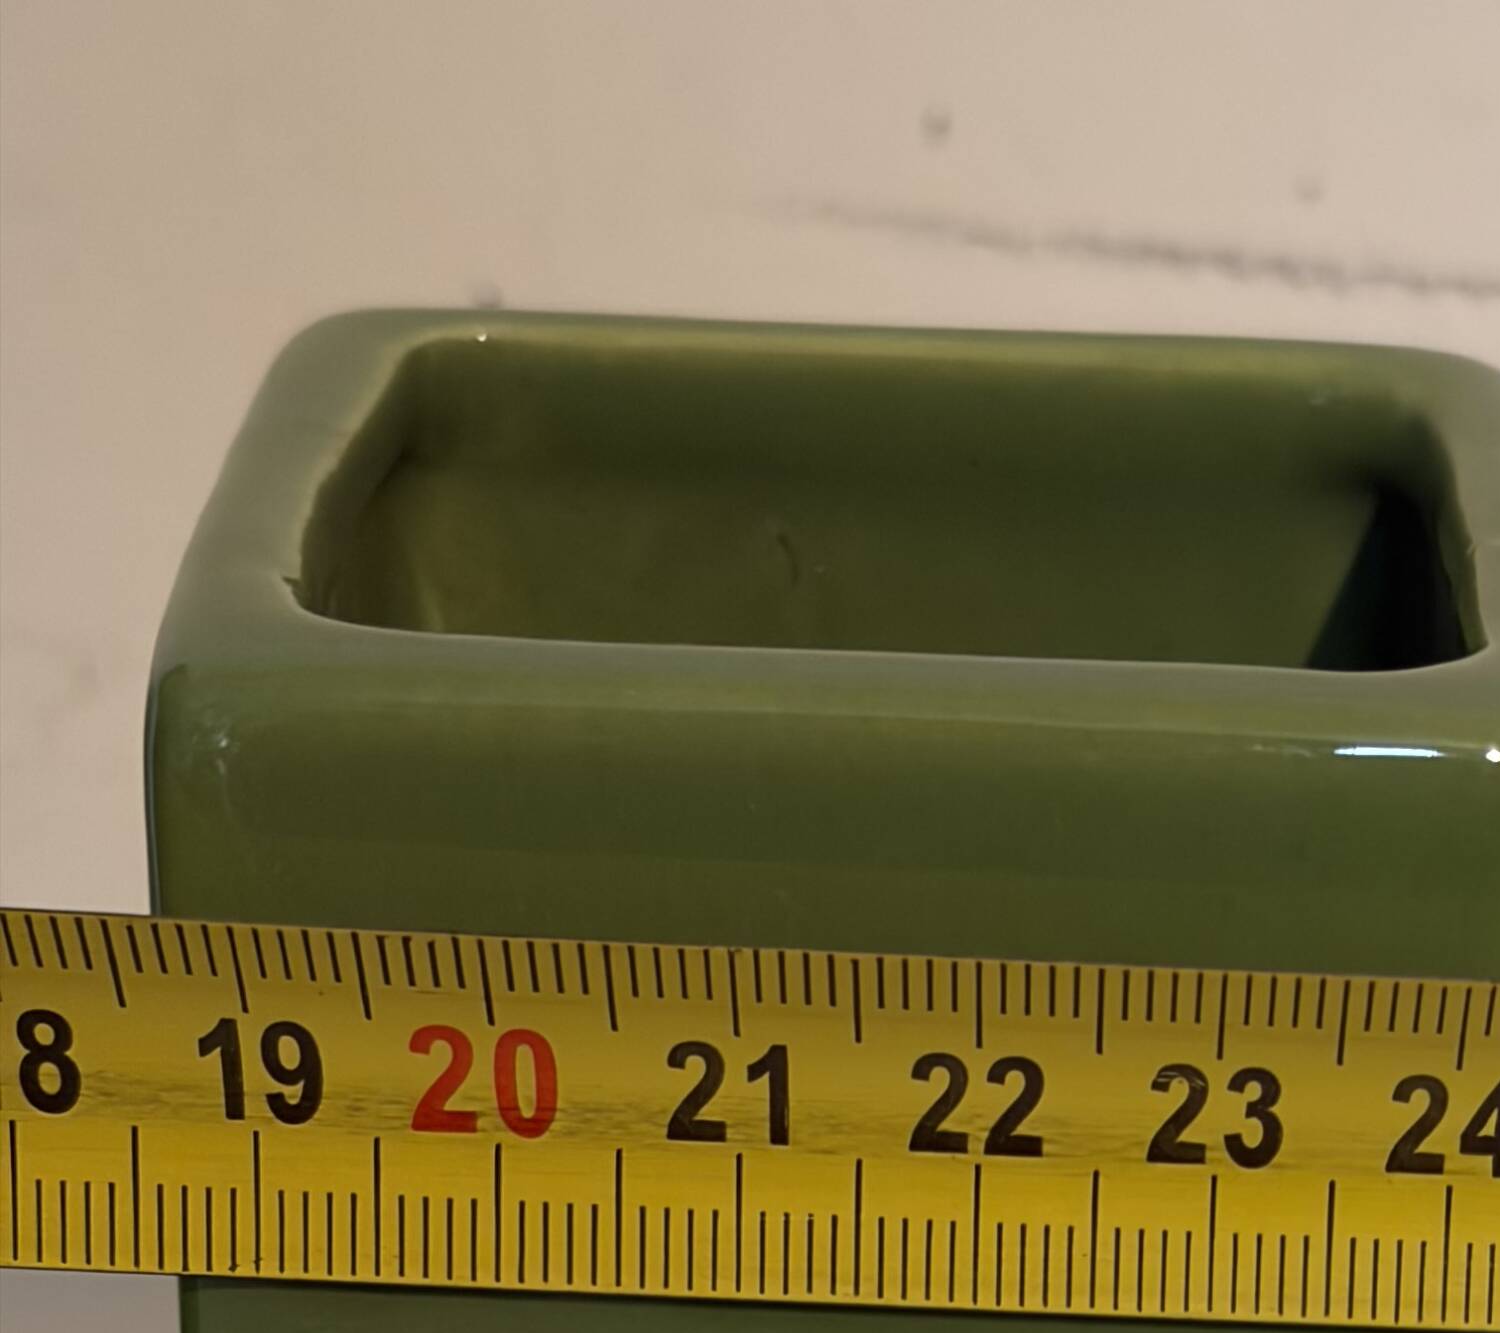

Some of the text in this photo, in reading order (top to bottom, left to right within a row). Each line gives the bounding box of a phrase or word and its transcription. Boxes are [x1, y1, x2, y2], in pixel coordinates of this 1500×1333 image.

[16, 1009, 81, 1114] 8
[198, 1017, 324, 1125] 19
[408, 1025, 558, 1138] 20
[665, 1041, 790, 1145] 21
[908, 1052, 1045, 1157] 22
[1146, 1063, 1284, 1169] 23
